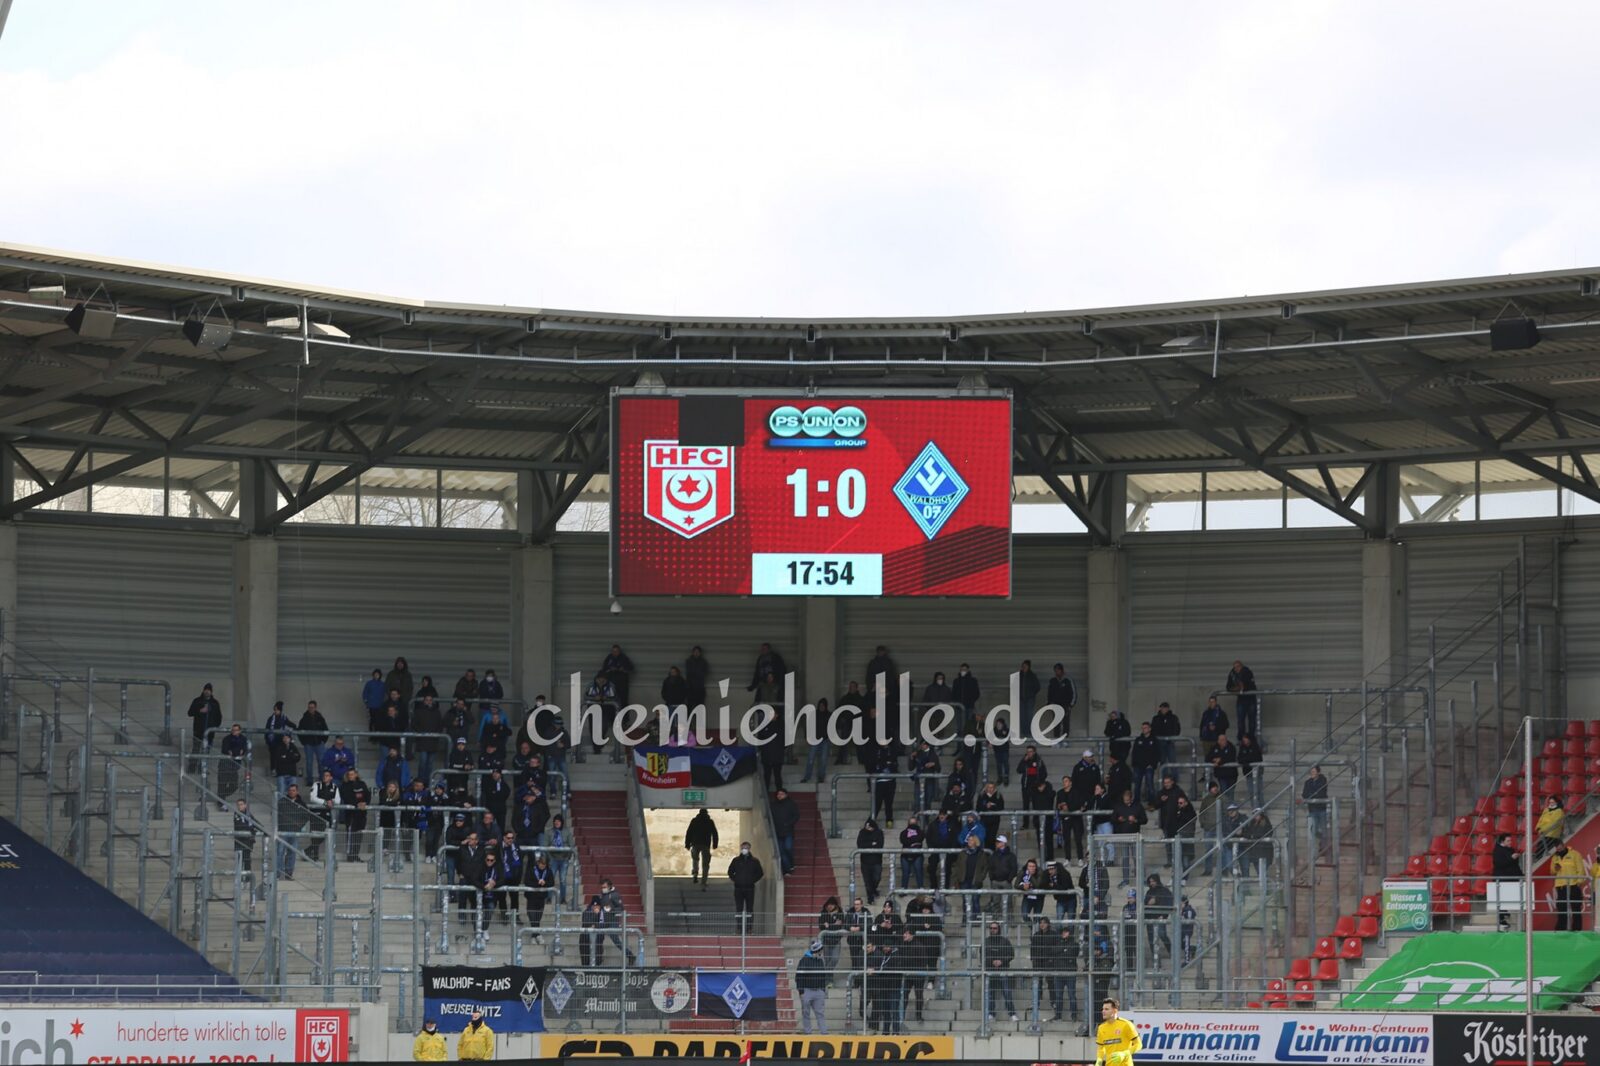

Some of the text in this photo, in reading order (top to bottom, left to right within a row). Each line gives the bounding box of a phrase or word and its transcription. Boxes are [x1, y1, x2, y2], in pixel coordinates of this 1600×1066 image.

[775, 416, 860, 427] PS UNION
[655, 448, 724, 465] HFC
[786, 468, 867, 518] 1:0
[923, 505, 943, 519] 07
[787, 561, 854, 585] 17:54
[1390, 893, 1423, 901] Wasser &
[1386, 902, 1427, 911] Entsorgung
[432, 977, 474, 990] WALDHOF
[484, 977, 511, 991] FANS
[441, 1003, 501, 1017] NEUSELWITZ
[584, 996, 637, 1014] Mannhim
[117, 1021, 287, 1041] hunderte wirklich tolle
[308, 1021, 335, 1034] HFC
[1164, 1022, 1259, 1031] Wohn-Centrum
[1329, 1024, 1428, 1033] Wohn-Centrum
[1133, 1024, 1260, 1060] ührmann
[1275, 1021, 1430, 1062] Lührmann
[1212, 1053, 1256, 1061] Saline
[1380, 1056, 1425, 1064] Saline
